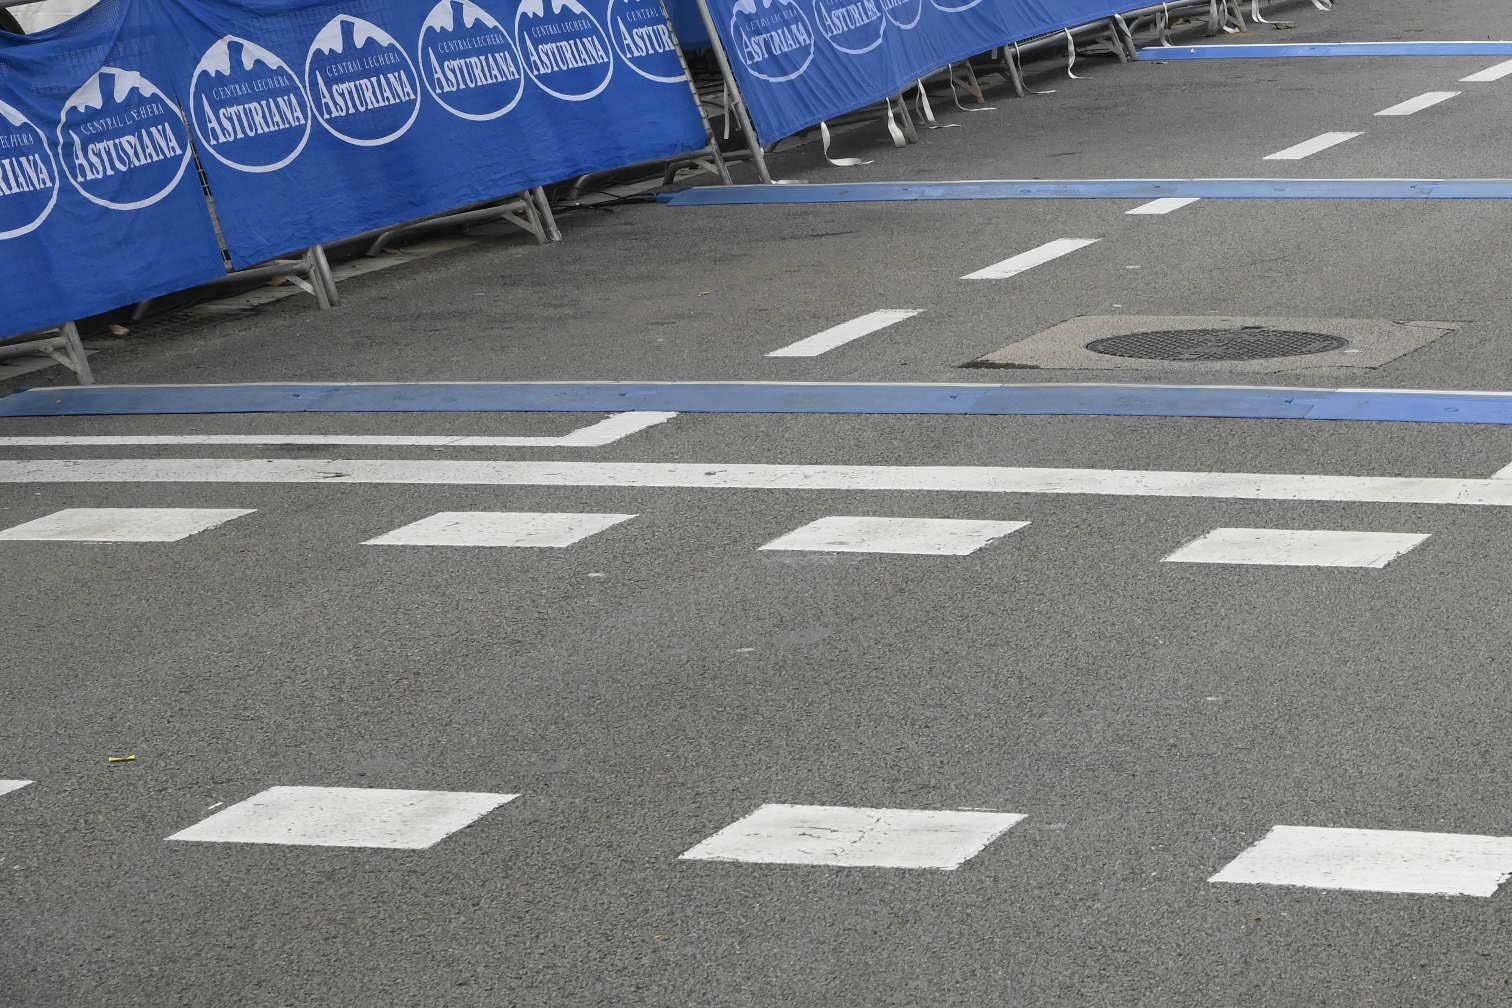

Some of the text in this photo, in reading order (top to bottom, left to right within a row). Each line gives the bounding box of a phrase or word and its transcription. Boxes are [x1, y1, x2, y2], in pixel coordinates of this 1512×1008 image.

[523, 30, 609, 76] ASTURIANA
[616, 15, 680, 59] ASTUR
[212, 74, 290, 100] CENTRAL LECHERA
[326, 51, 400, 78] CENTRAL LECHERA
[428, 45, 521, 94] ASTURIANA
[315, 69, 417, 120] ASTURIANA
[80, 114, 123, 136] CENTRAL
[200, 93, 306, 146] ASTURIANA
[68, 121, 183, 182] ASTURIANA
[0, 153, 52, 196] RIANA
